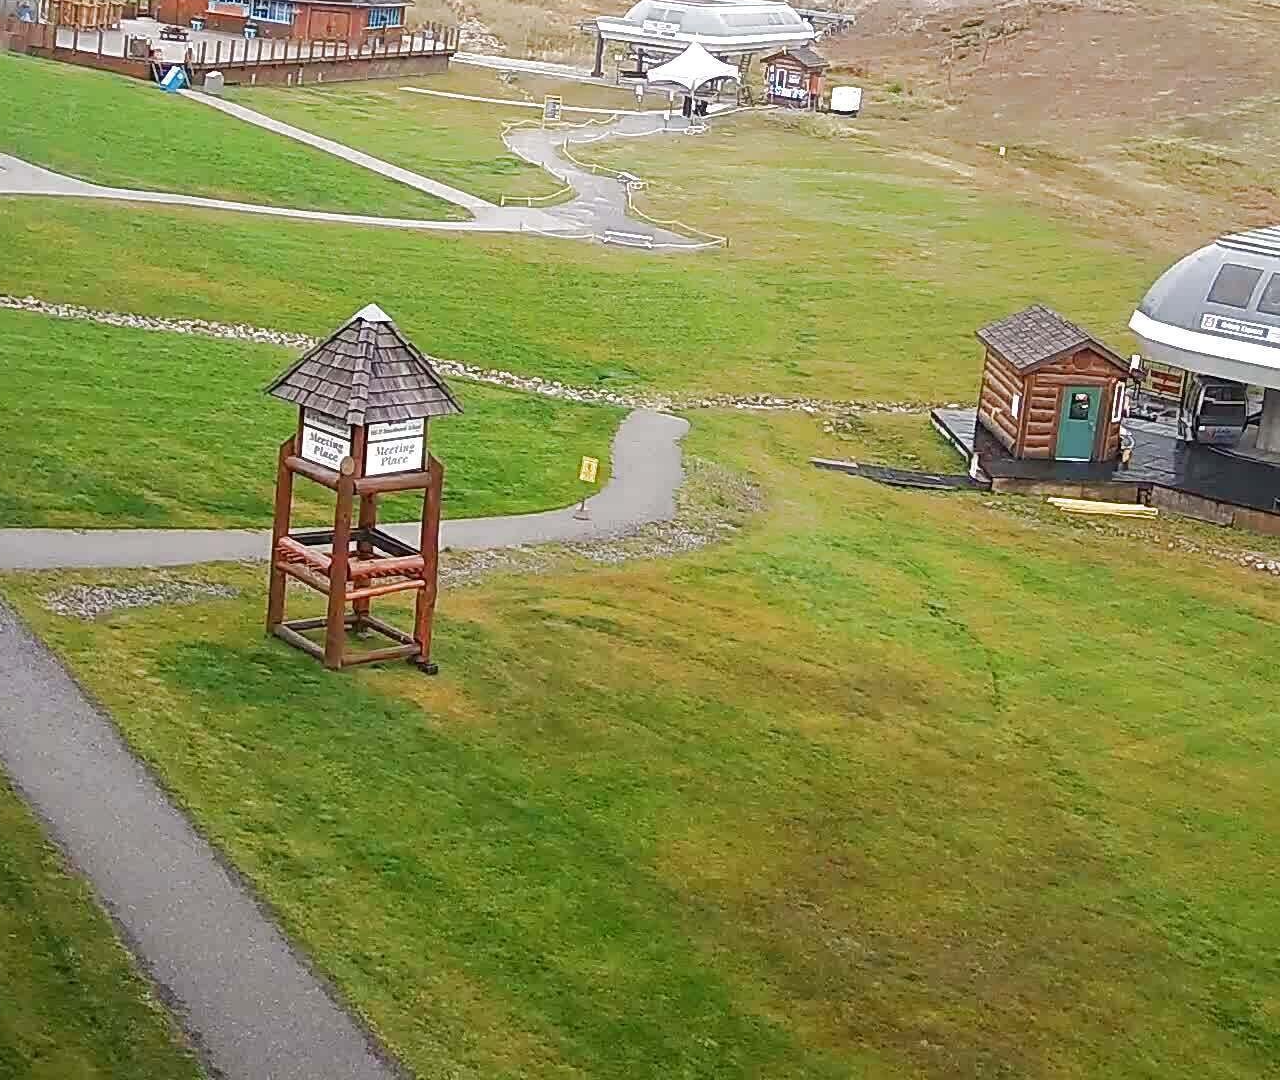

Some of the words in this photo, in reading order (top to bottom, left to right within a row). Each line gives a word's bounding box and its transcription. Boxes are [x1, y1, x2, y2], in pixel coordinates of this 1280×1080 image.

[308, 432, 344, 454] Meeting
[376, 443, 415, 457] Meeting
[313, 445, 339, 462] Place
[381, 455, 408, 466] Place
